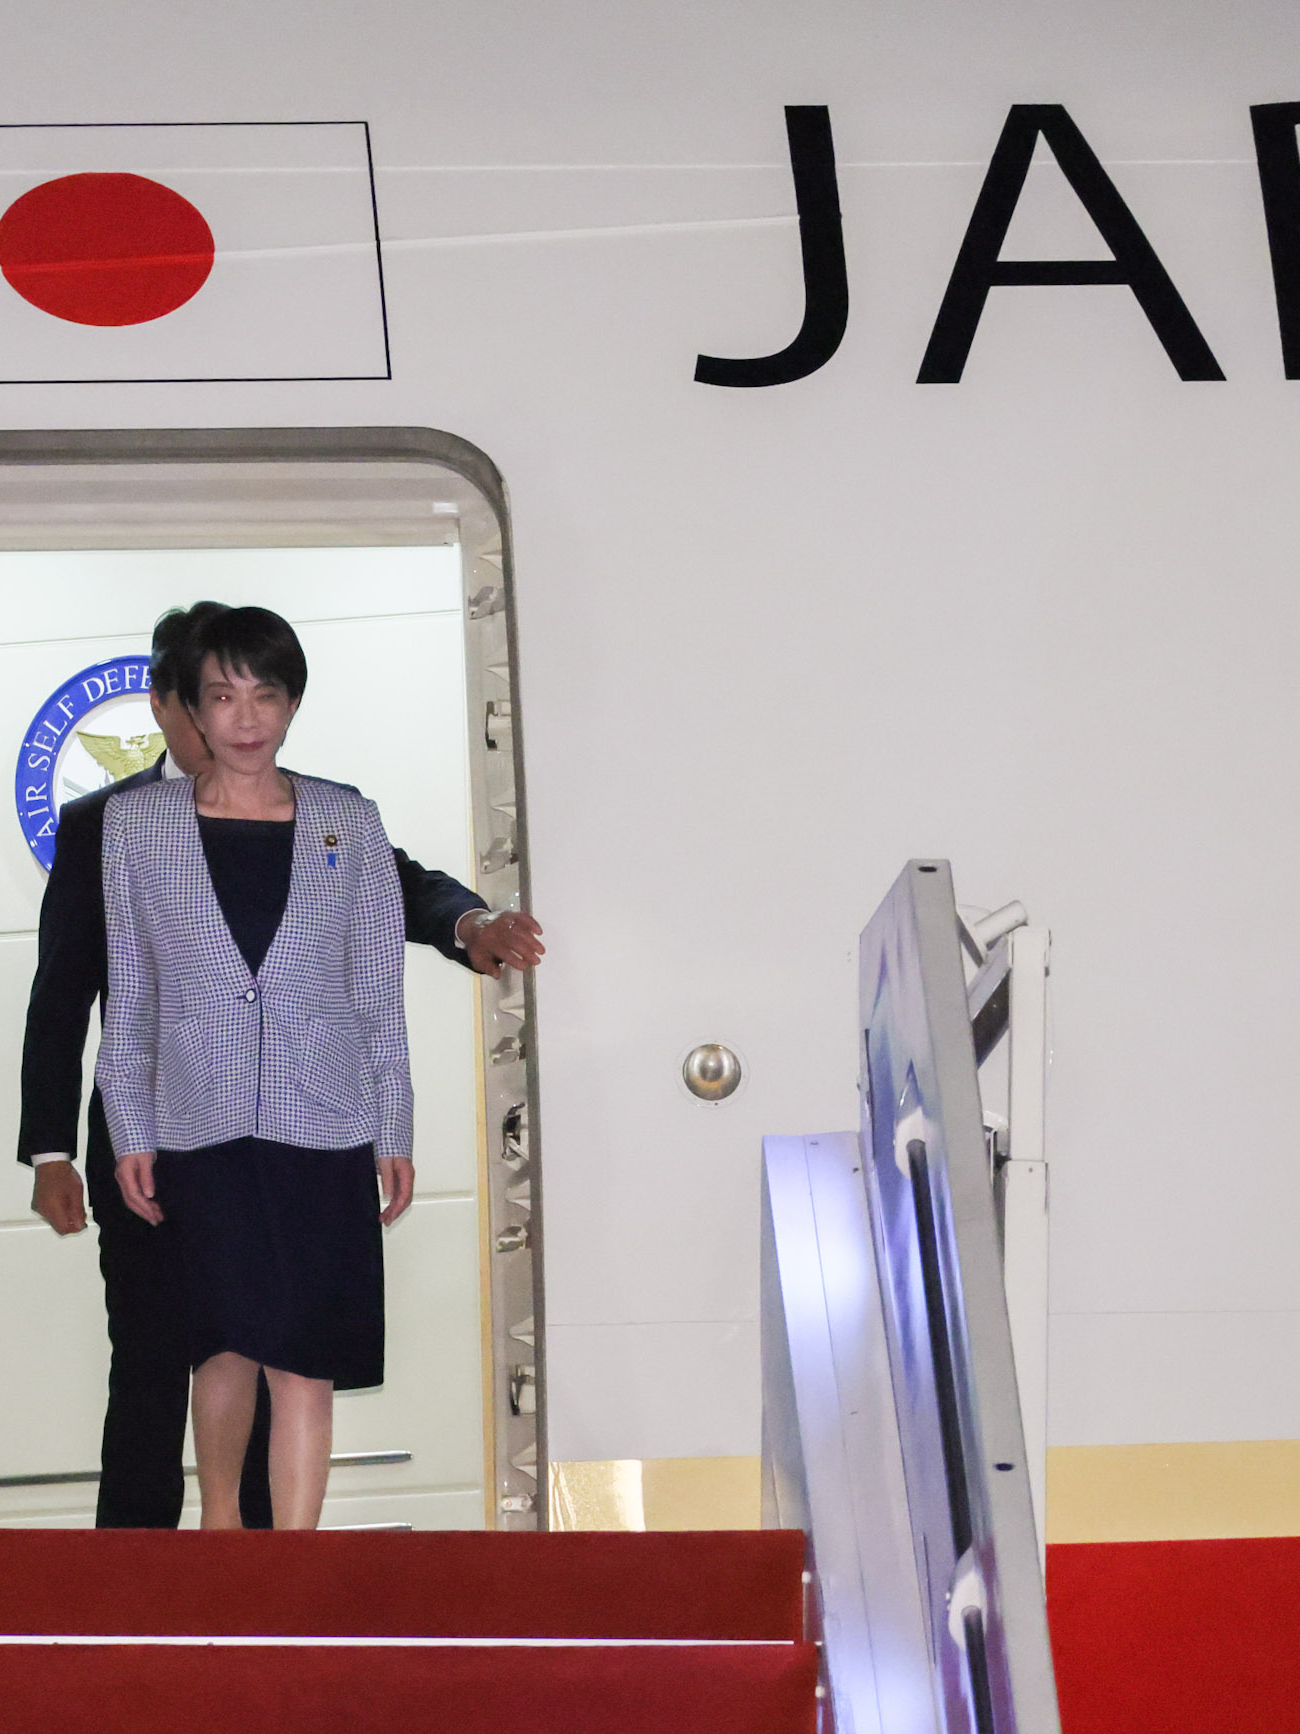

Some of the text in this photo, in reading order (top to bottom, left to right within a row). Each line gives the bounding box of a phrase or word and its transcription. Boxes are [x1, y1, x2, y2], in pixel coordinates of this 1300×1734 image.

[25, 664, 151, 838] AIR SELF DEFE
